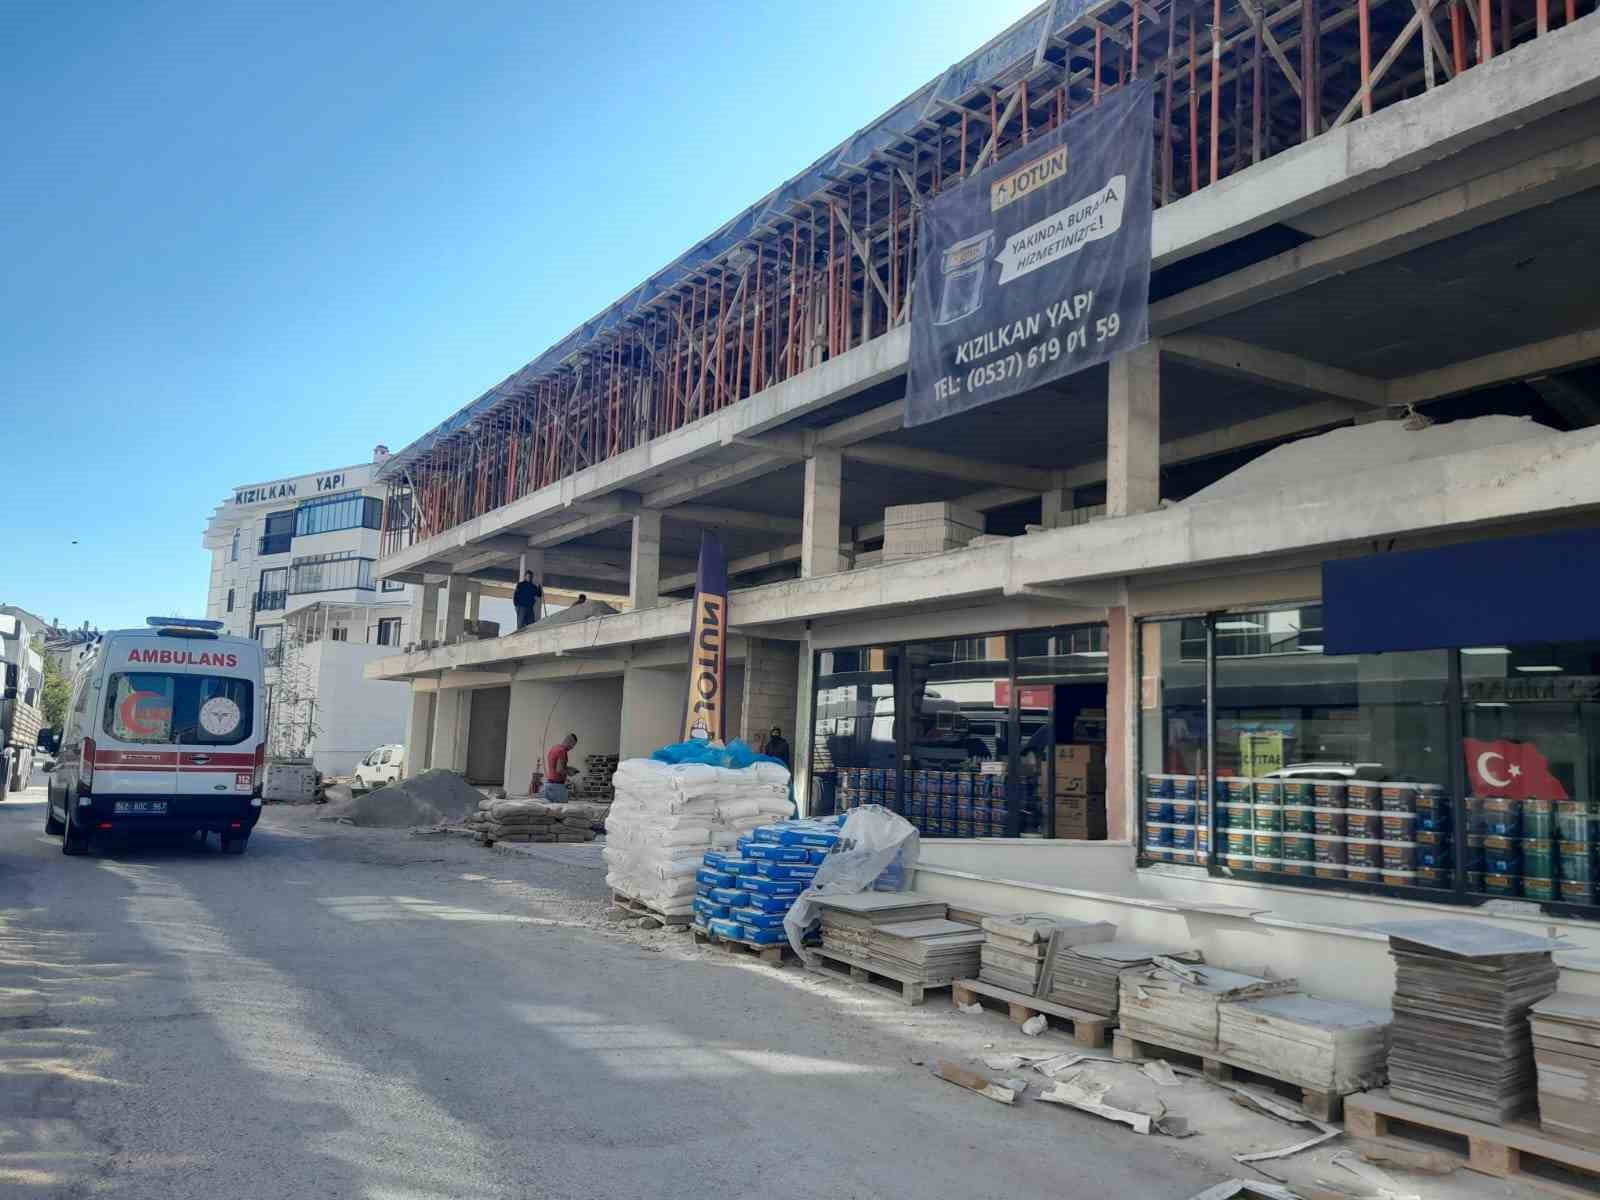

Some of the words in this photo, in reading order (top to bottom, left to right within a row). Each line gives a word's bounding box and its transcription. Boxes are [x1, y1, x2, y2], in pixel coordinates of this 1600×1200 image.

[1009, 153, 1064, 198] JOTUN
[1011, 221, 1064, 255] YAKINDA
[954, 313, 1041, 365] KIZILKAN
[1046, 290, 1093, 328] YAPI
[933, 375, 961, 401] TEL:
[966, 351, 1023, 393] (0537)
[1027, 337, 1061, 369] 619
[1067, 325, 1087, 353] 01
[1096, 312, 1120, 343] 59
[235, 483, 297, 505] KIZILKAN
[316, 473, 345, 492] YAPI
[128, 647, 238, 668] AMBULANS
[238, 775, 251, 784] 112
